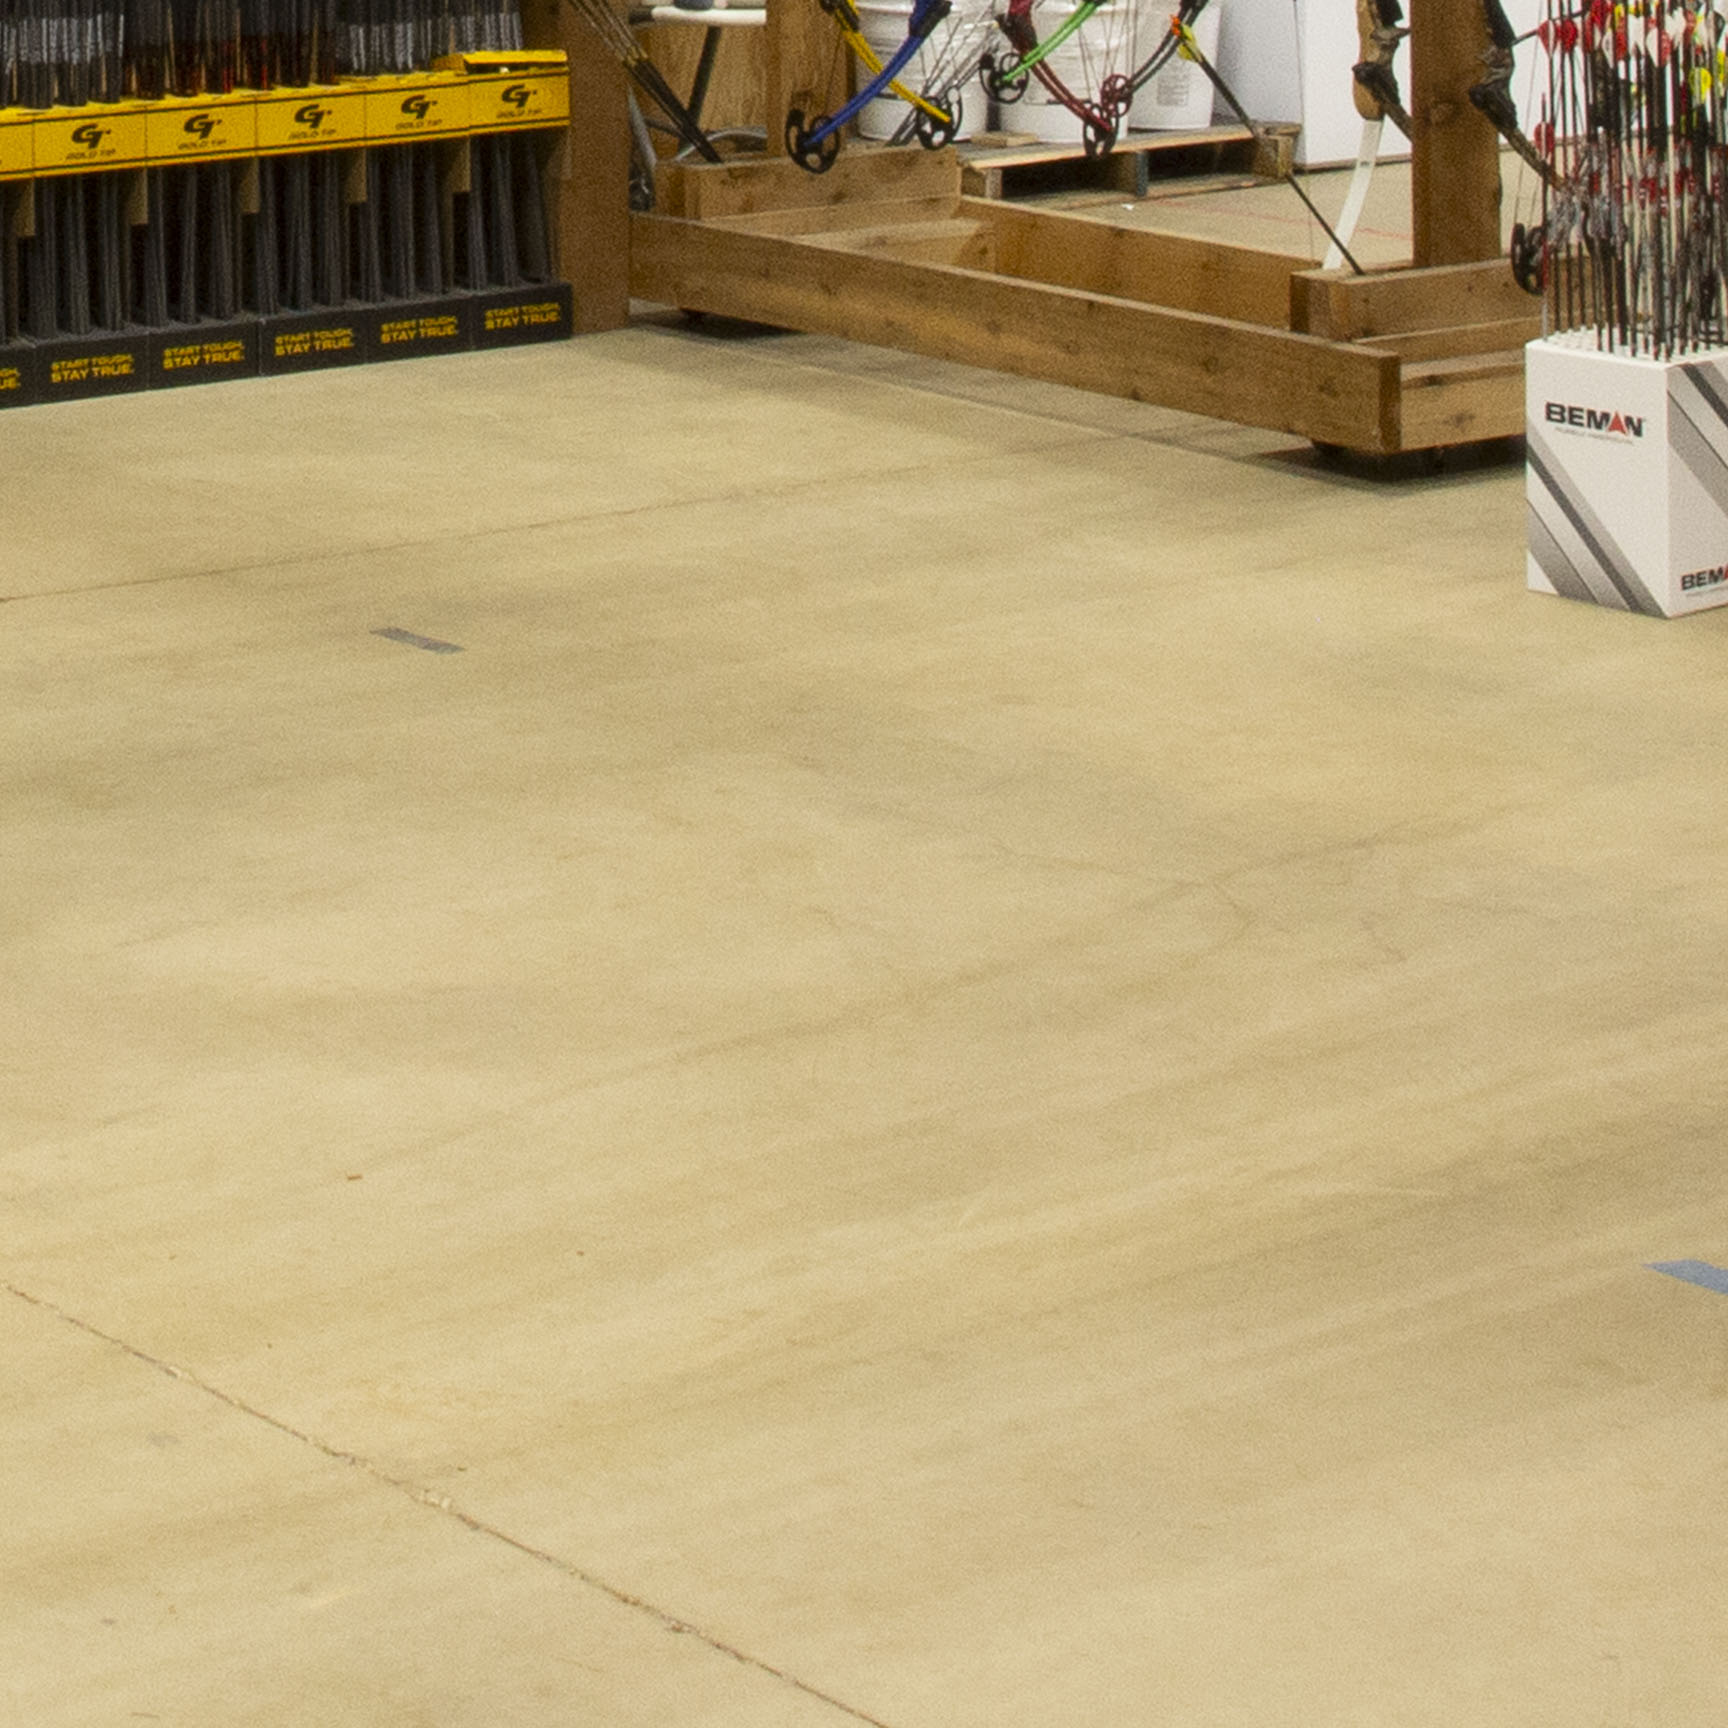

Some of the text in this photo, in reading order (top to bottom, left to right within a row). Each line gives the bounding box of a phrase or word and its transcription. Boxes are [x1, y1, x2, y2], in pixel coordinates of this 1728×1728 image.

[485, 317, 519, 331] STAY
[381, 330, 418, 344] STAY
[275, 343, 311, 357] STAY
[163, 355, 201, 370] STAY
[51, 369, 91, 383] STAY
[1545, 401, 1646, 438] BEMAN
